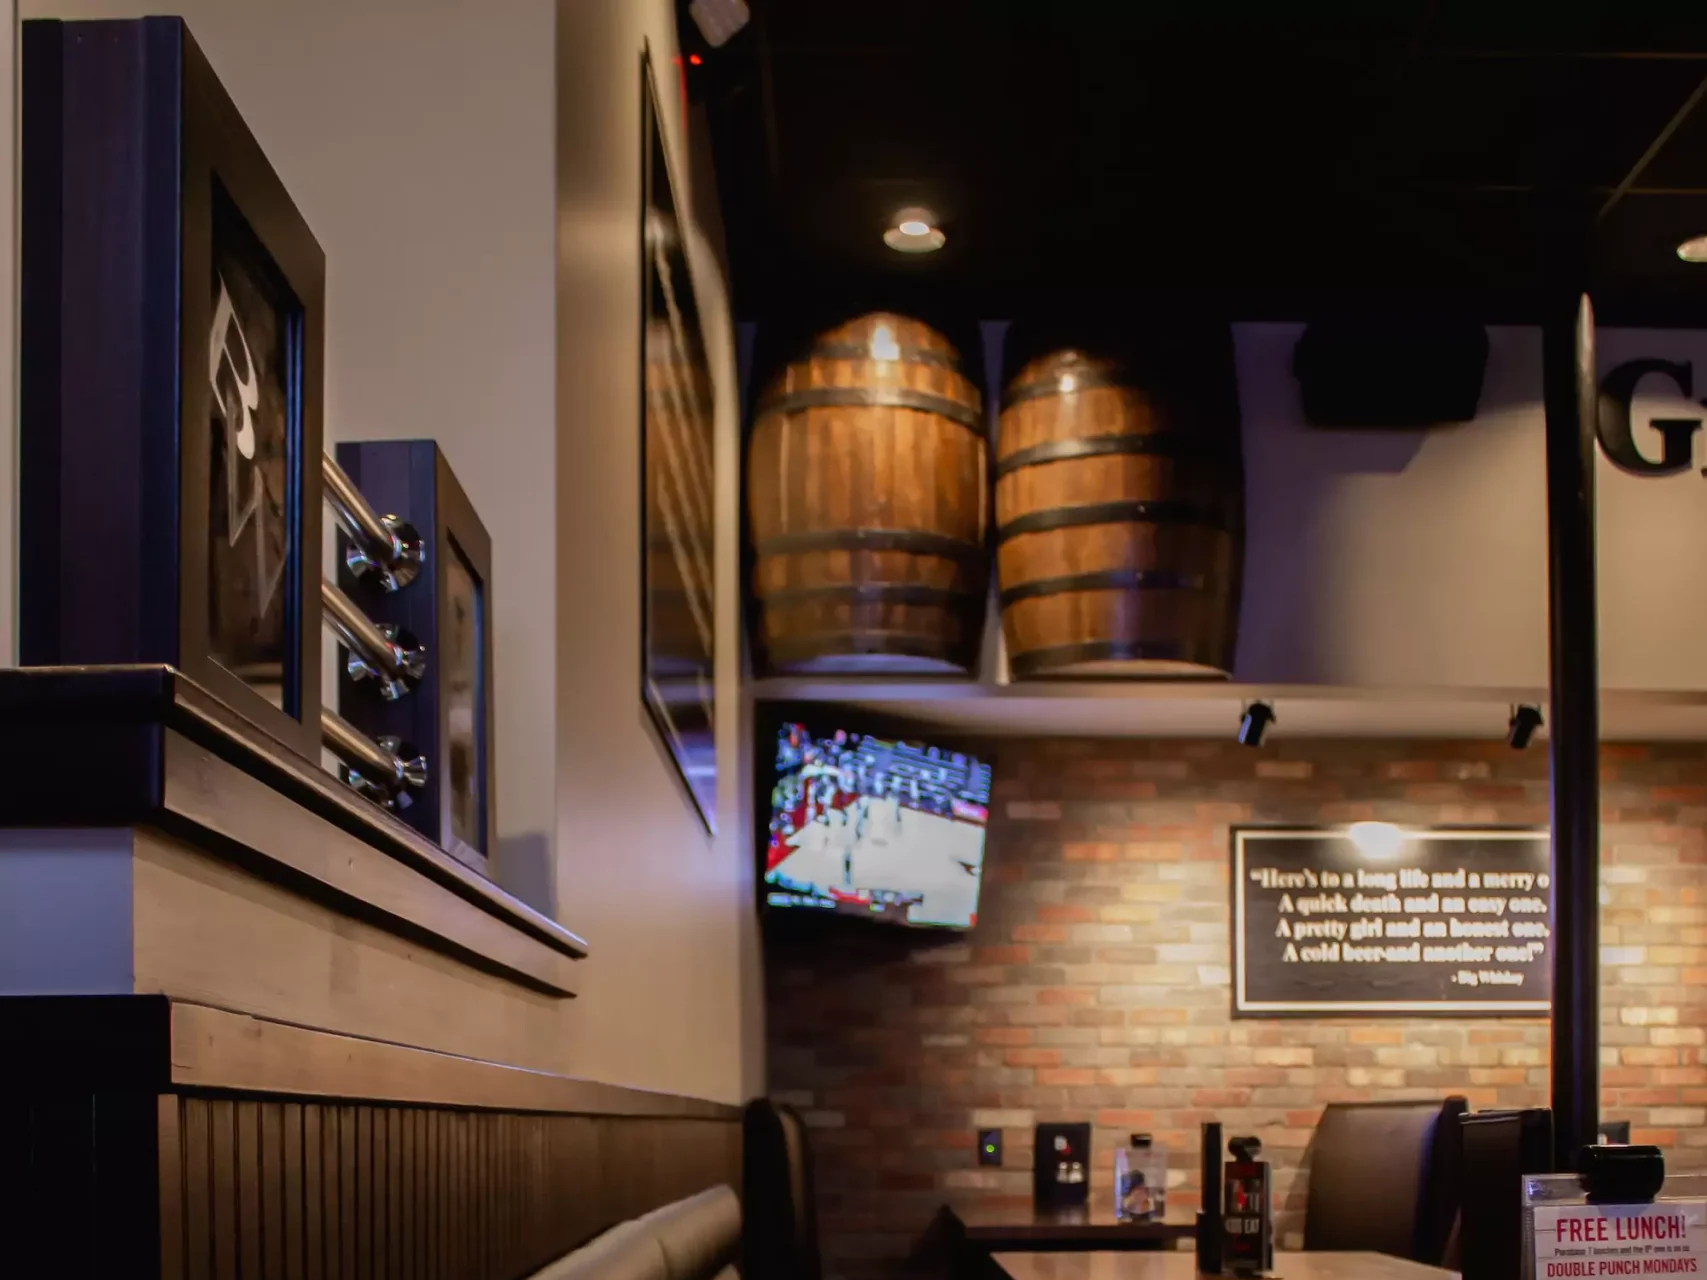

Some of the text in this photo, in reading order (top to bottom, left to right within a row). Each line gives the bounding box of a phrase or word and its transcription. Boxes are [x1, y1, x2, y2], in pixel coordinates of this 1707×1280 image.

[1597, 357, 1707, 479] G
[1321, 870, 1340, 888] to
[1342, 873, 1354, 888] a
[1357, 868, 1397, 891] long
[1400, 868, 1429, 888] life
[1432, 868, 1466, 888] and
[1468, 873, 1480, 888] a
[1483, 873, 1535, 891] merry
[1278, 893, 1294, 913] A
[1296, 892, 1348, 916] quick
[1350, 893, 1401, 913] death
[1404, 892, 1439, 913] and
[1442, 897, 1465, 913] an
[1275, 918, 1291, 937] A
[1294, 919, 1348, 940] pretty
[1349, 917, 1383, 940] girl
[1385, 917, 1420, 937] and
[1423, 921, 1447, 938] an
[1450, 917, 1509, 938] honest
[1282, 942, 1298, 962] A
[1300, 942, 1340, 962] cold
[1422, 942, 1494, 962] another
[1556, 1215, 1686, 1242] FREE LUNCH!
[1547, 1258, 1697, 1277] DOUBLE PUNCH MONDAYS
